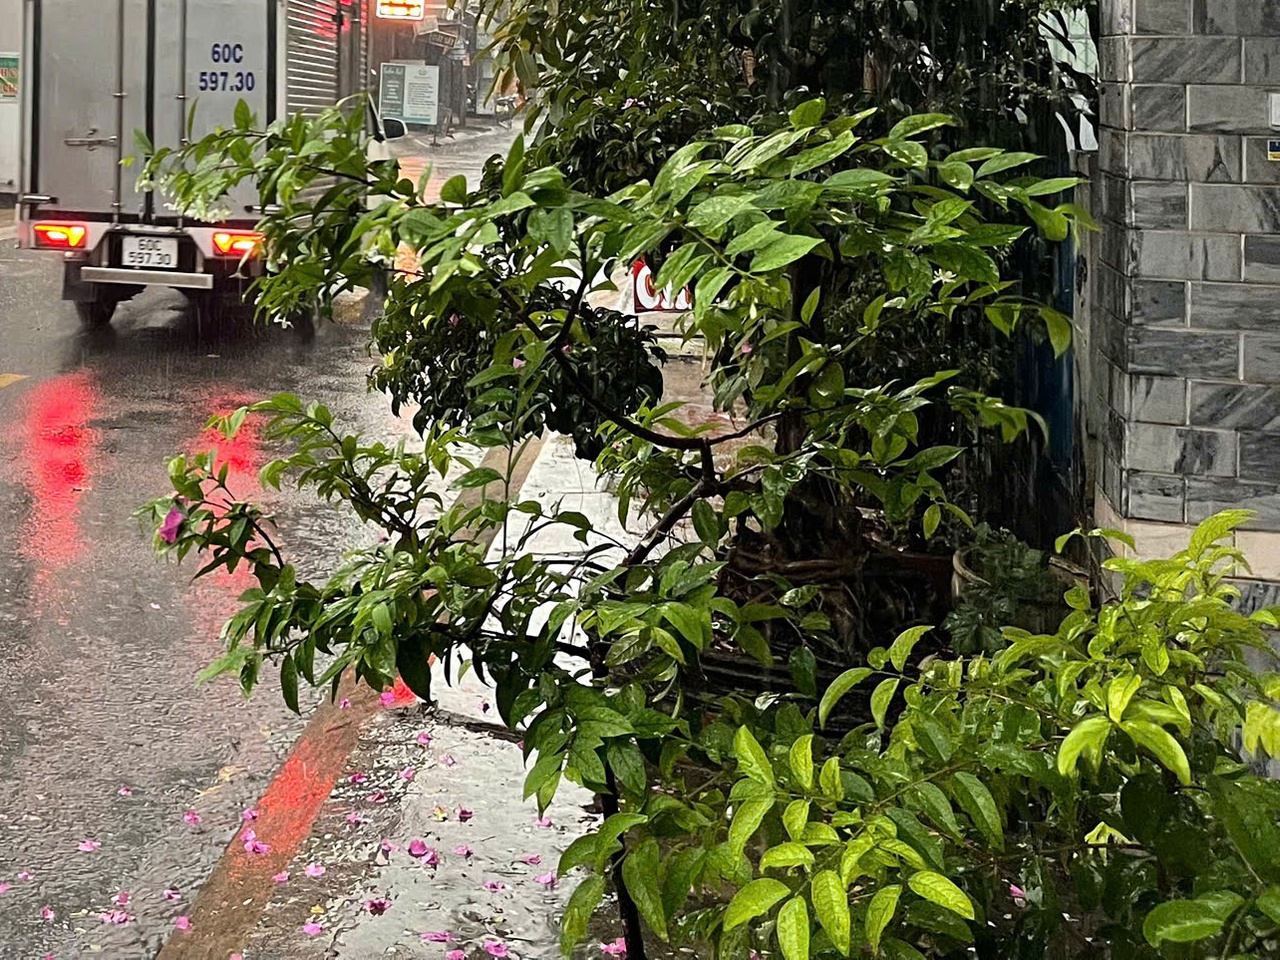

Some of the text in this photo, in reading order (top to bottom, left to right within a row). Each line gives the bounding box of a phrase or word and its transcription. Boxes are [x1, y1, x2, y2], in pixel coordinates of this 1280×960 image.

[211, 43, 244, 63] 60C
[199, 71, 255, 91] 597.30
[129, 251, 171, 265] 597.30
